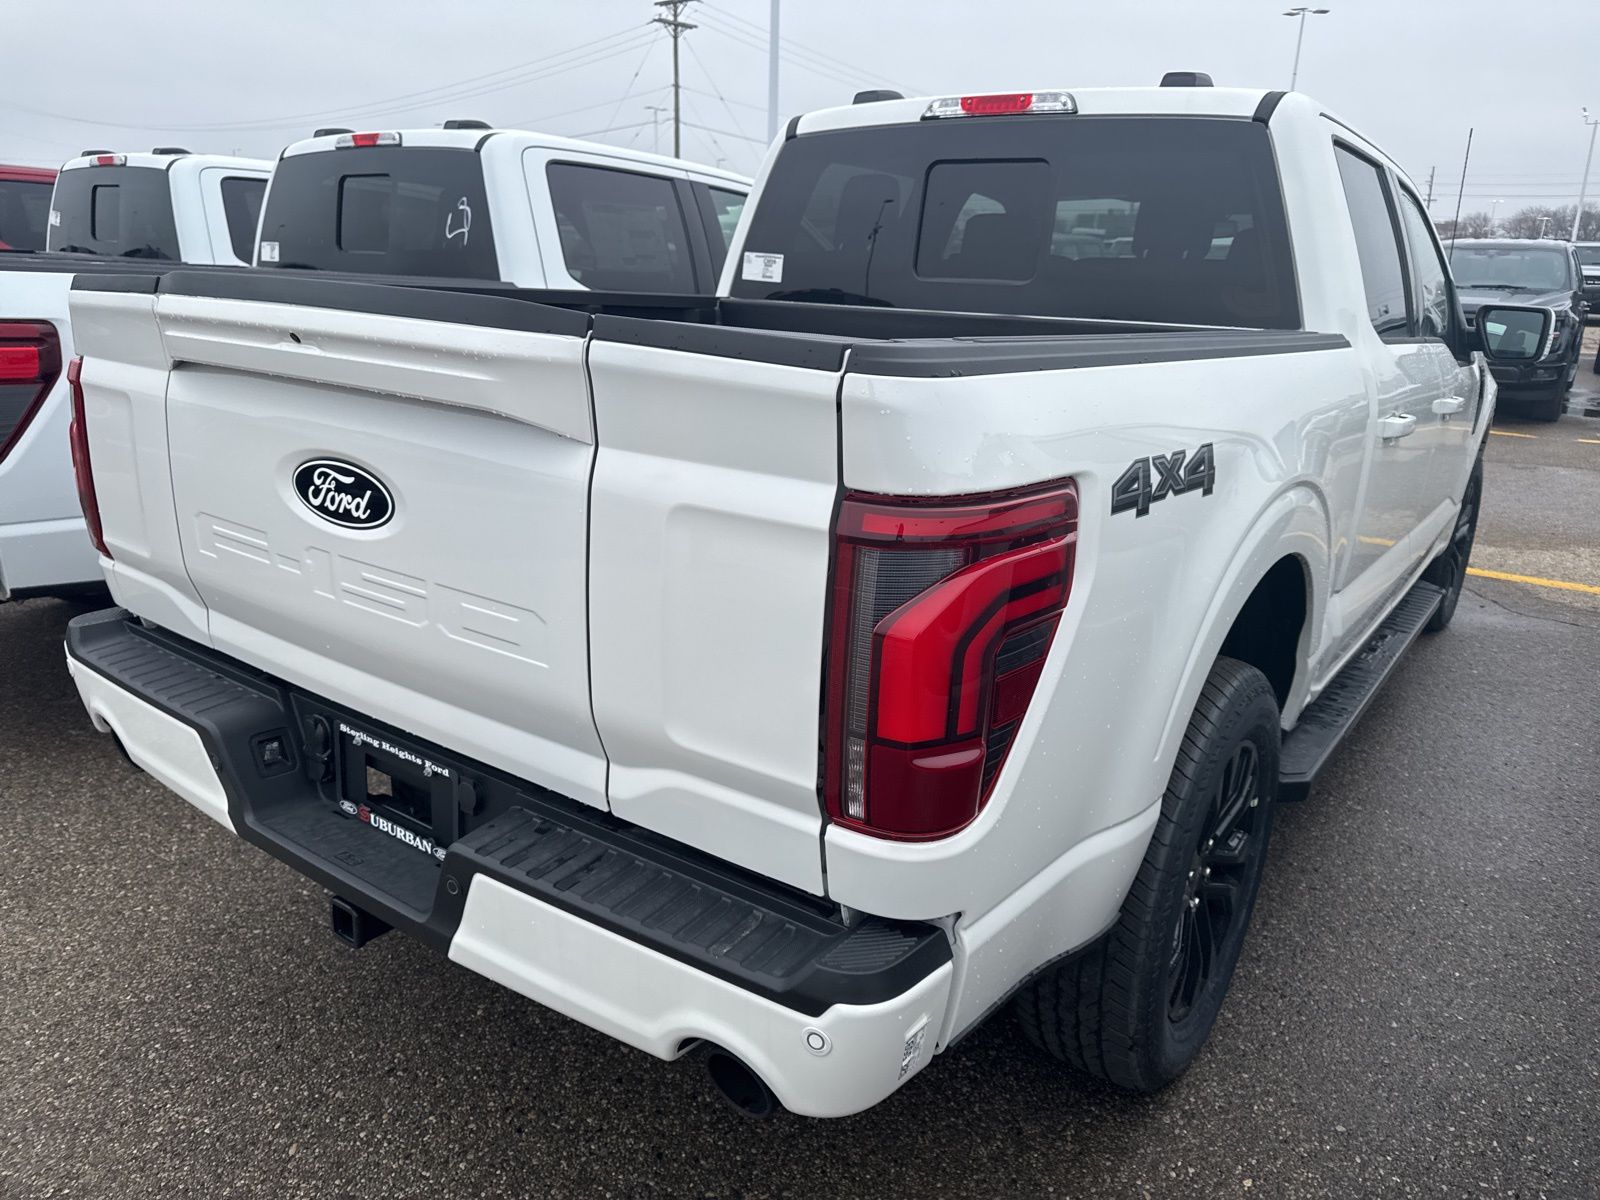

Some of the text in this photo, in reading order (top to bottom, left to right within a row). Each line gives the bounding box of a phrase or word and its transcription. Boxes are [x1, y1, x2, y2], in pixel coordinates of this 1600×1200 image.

[308, 467, 372, 519] Ford
[194, 511, 550, 668] F-150
[339, 723, 450, 778] Sterling Heights Ford
[357, 804, 432, 855] SUBURBAN
